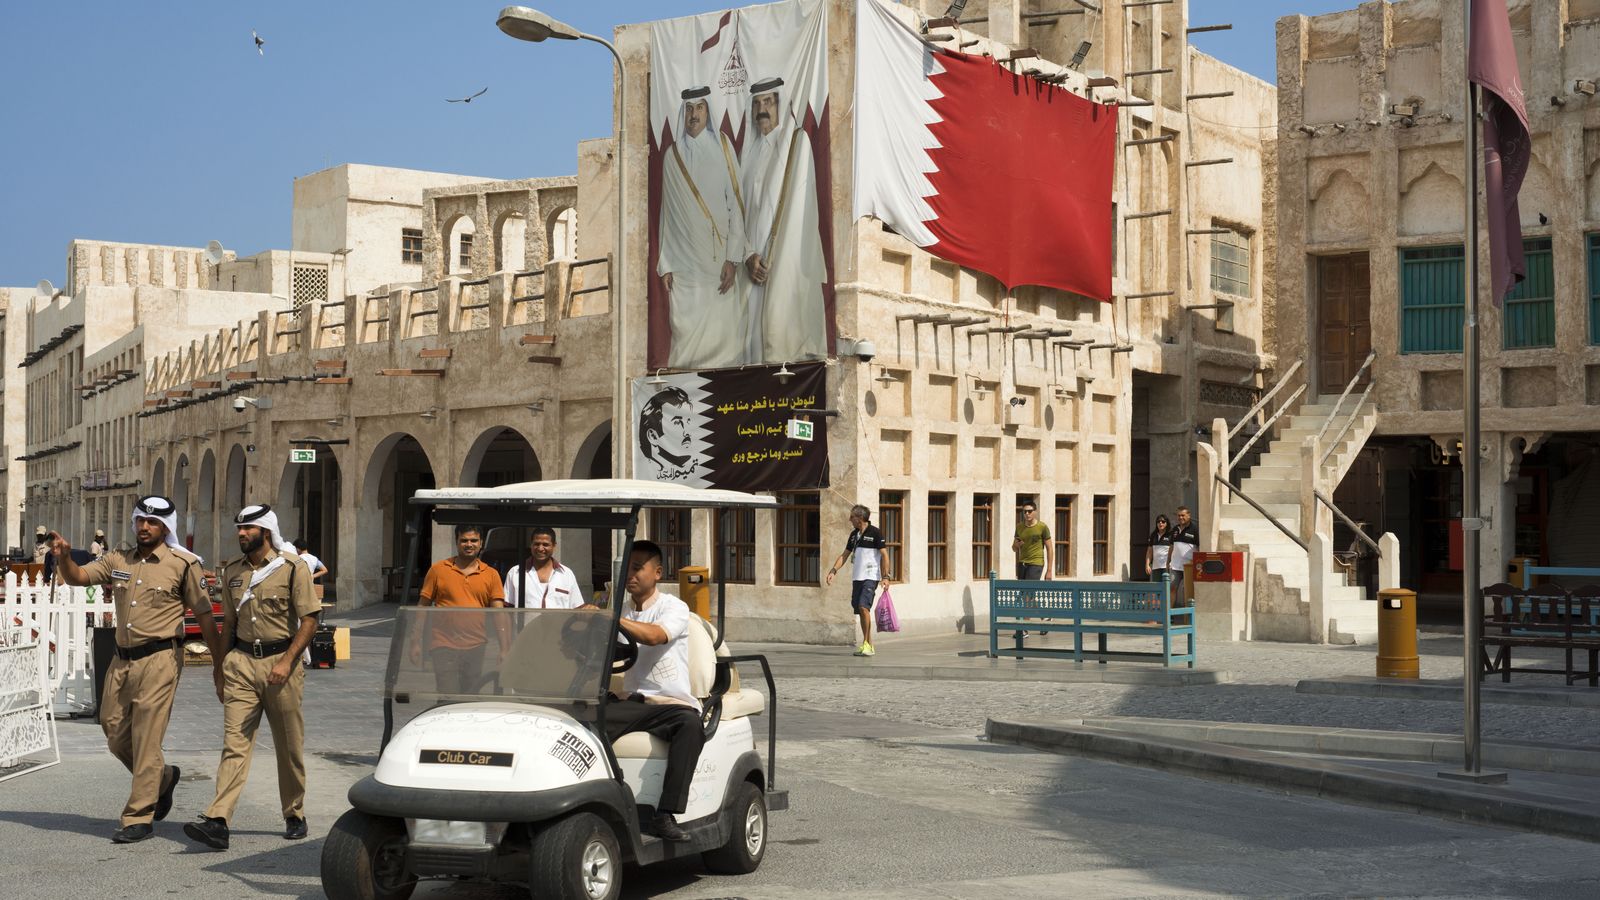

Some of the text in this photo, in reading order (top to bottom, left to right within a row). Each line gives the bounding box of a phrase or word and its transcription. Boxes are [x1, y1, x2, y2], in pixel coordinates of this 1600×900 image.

[717, 395, 815, 414] للوطن لك يا قطر منا عهد
[766, 421, 783, 436] تميم
[746, 447, 768, 464] نرجع
[782, 445, 803, 460] نسير
[437, 751, 492, 764] Club Car
[548, 741, 589, 780] canteen
